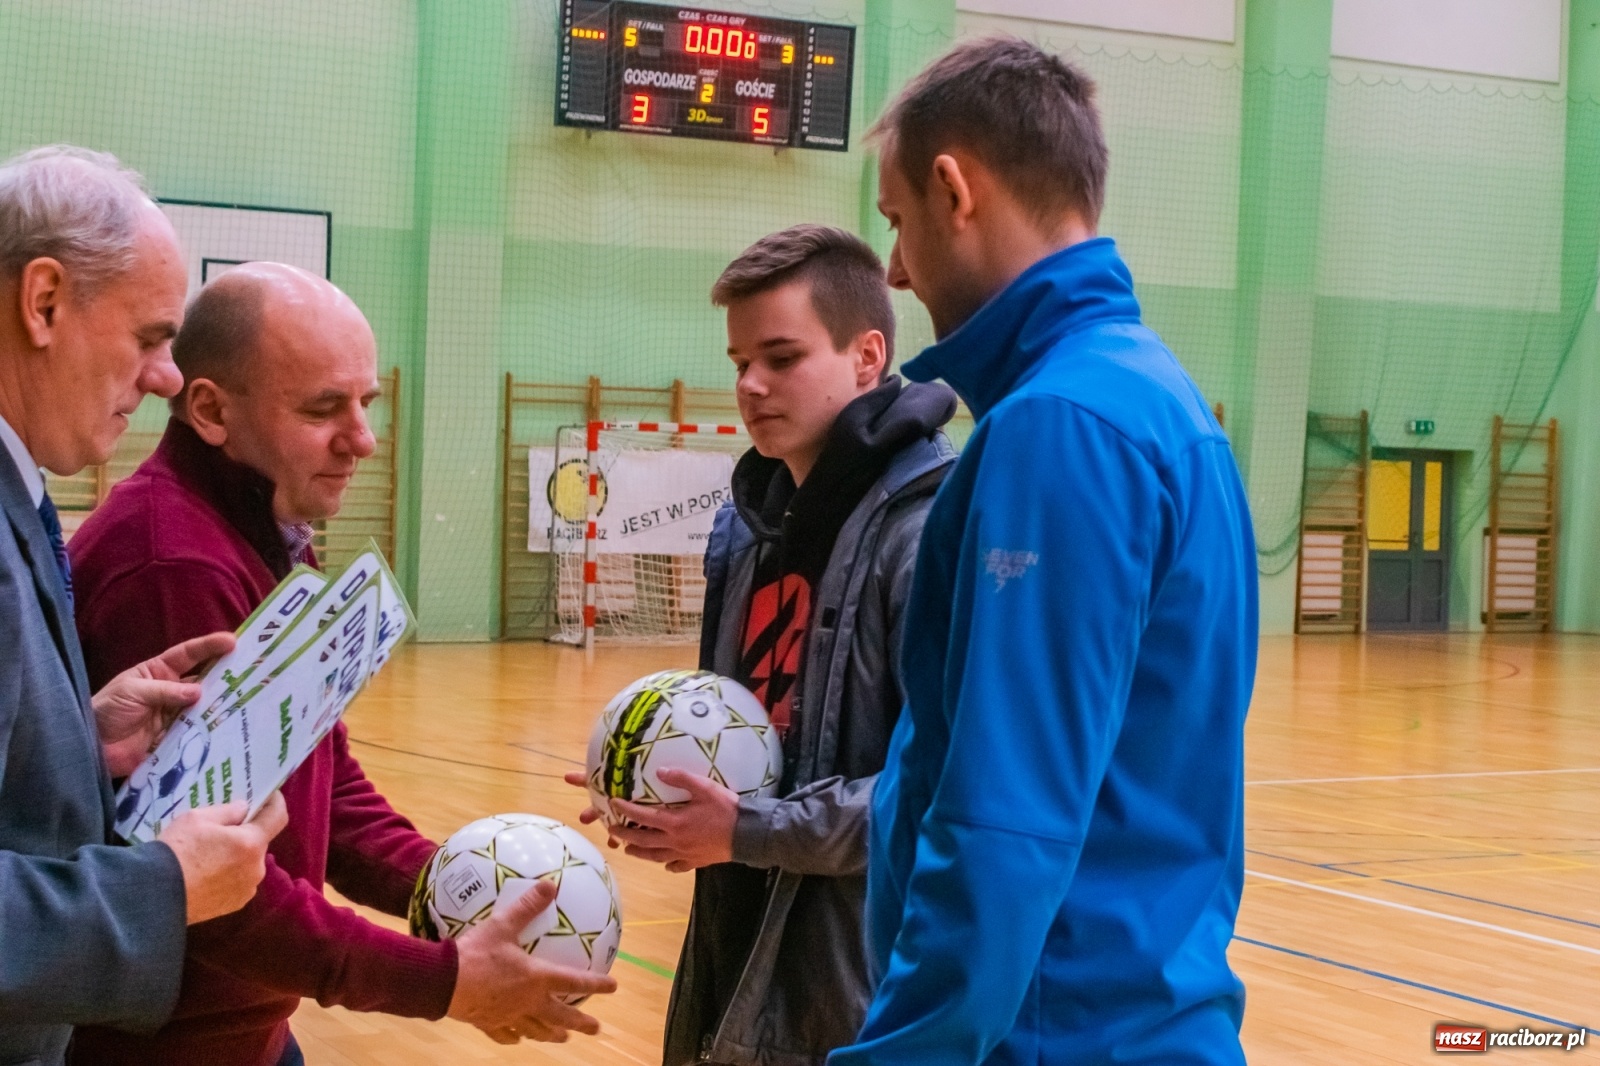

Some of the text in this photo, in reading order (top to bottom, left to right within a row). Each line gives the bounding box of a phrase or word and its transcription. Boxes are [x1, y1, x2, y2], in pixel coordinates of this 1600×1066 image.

[678, 10, 700, 20] CZAS
[706, 14, 728, 24] CZAS
[728, 17, 747, 25] GRY
[624, 27, 637, 47] 5
[782, 44, 794, 64] 3
[624, 68, 776, 98] GOSPODARZE GOŚCIE
[701, 84, 714, 102] 2
[632, 96, 650, 122] 3
[687, 108, 706, 122] 3D
[752, 107, 769, 134] 5
[620, 508, 661, 535] JEST
[666, 502, 684, 520] W
[458, 879, 482, 902] IMS
